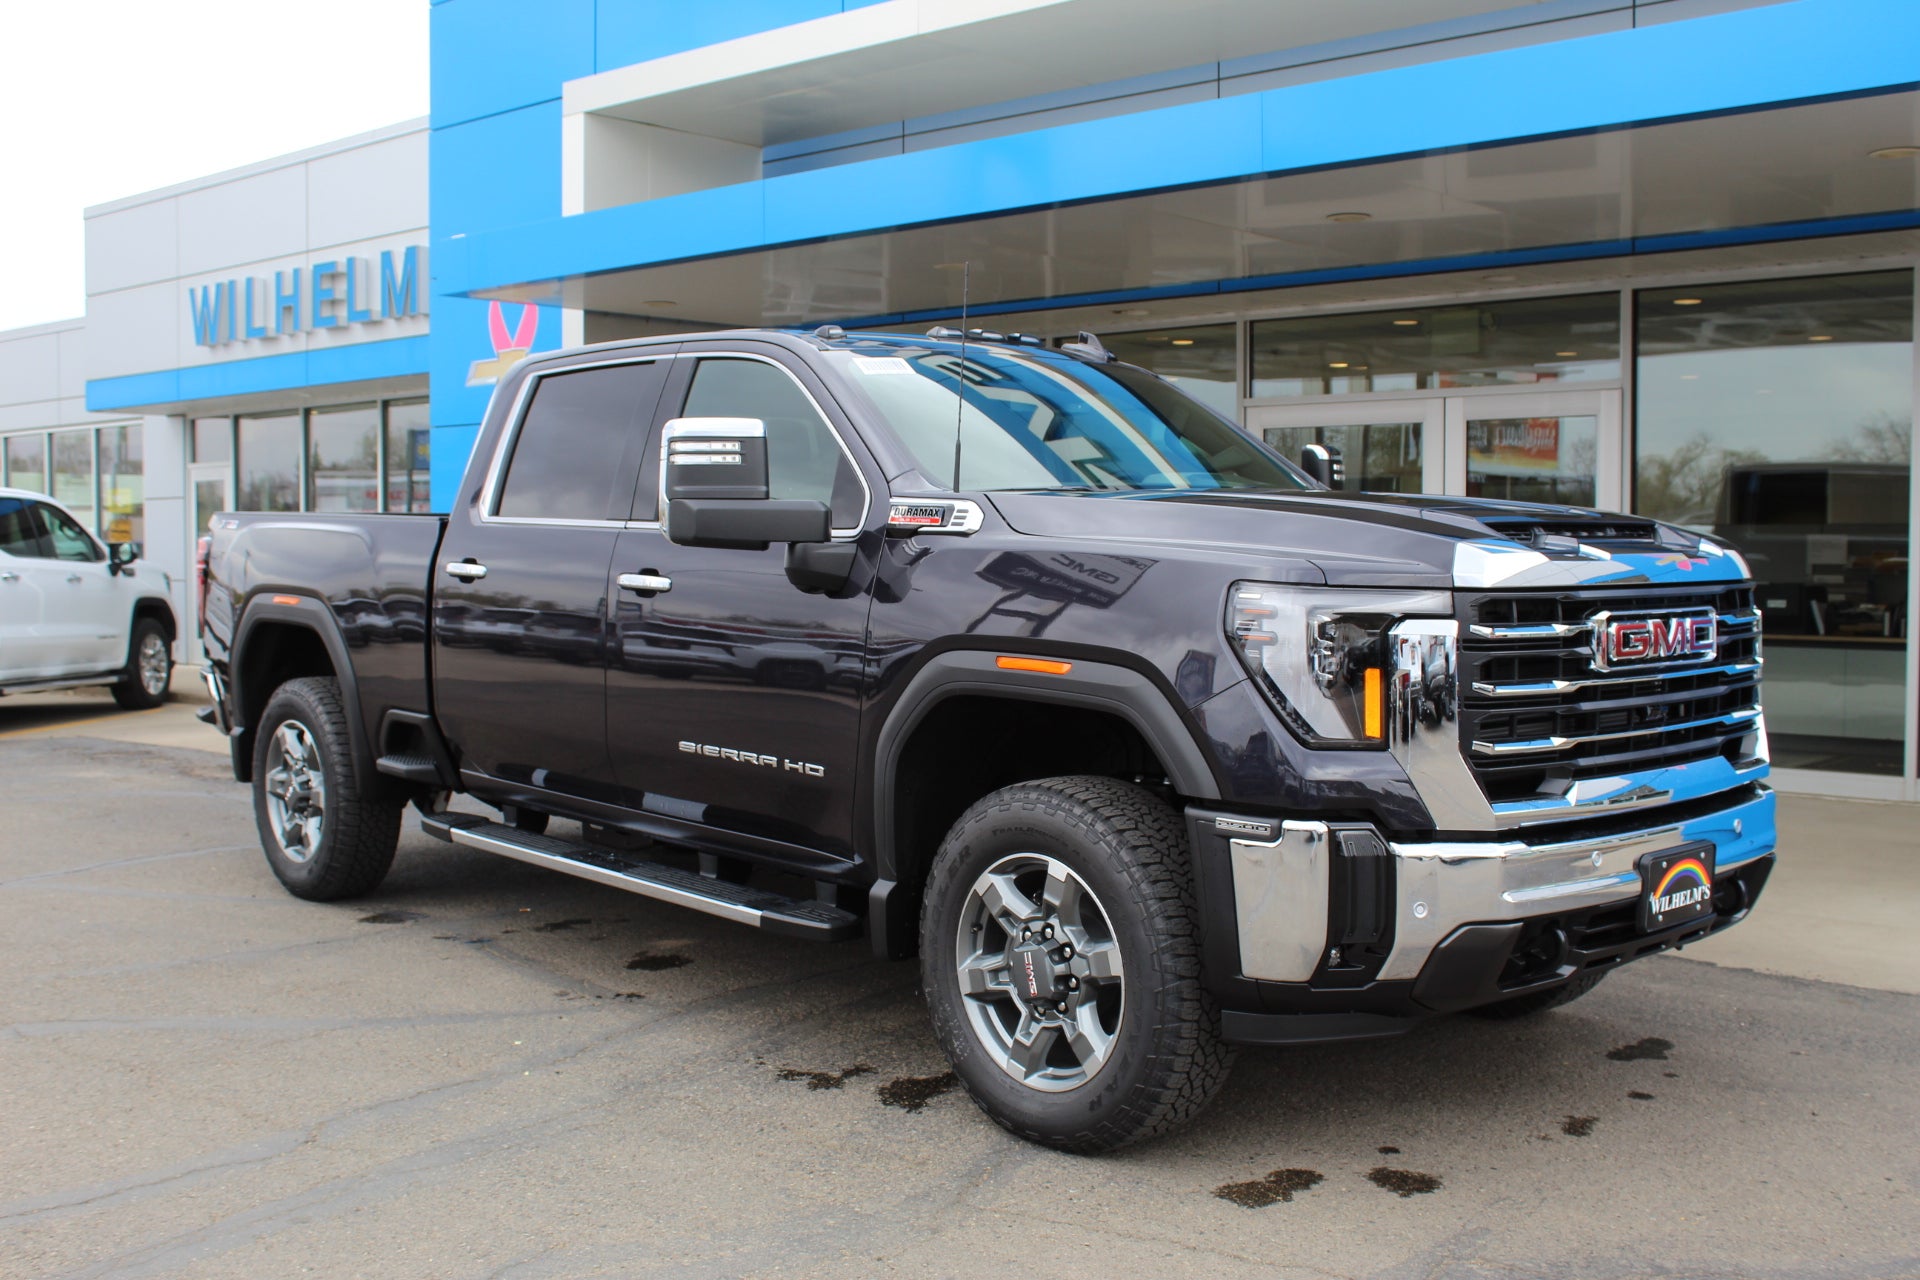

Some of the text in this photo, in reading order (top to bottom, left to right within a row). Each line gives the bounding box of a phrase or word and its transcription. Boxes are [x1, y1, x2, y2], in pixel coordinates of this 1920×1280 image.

[189, 245, 418, 347] WILHELM
[893, 506, 941, 518] DURAMAX
[1610, 617, 1714, 661] GMC
[678, 740, 825, 778] SIERRA HD
[1649, 884, 1711, 915] WILHELM'S
